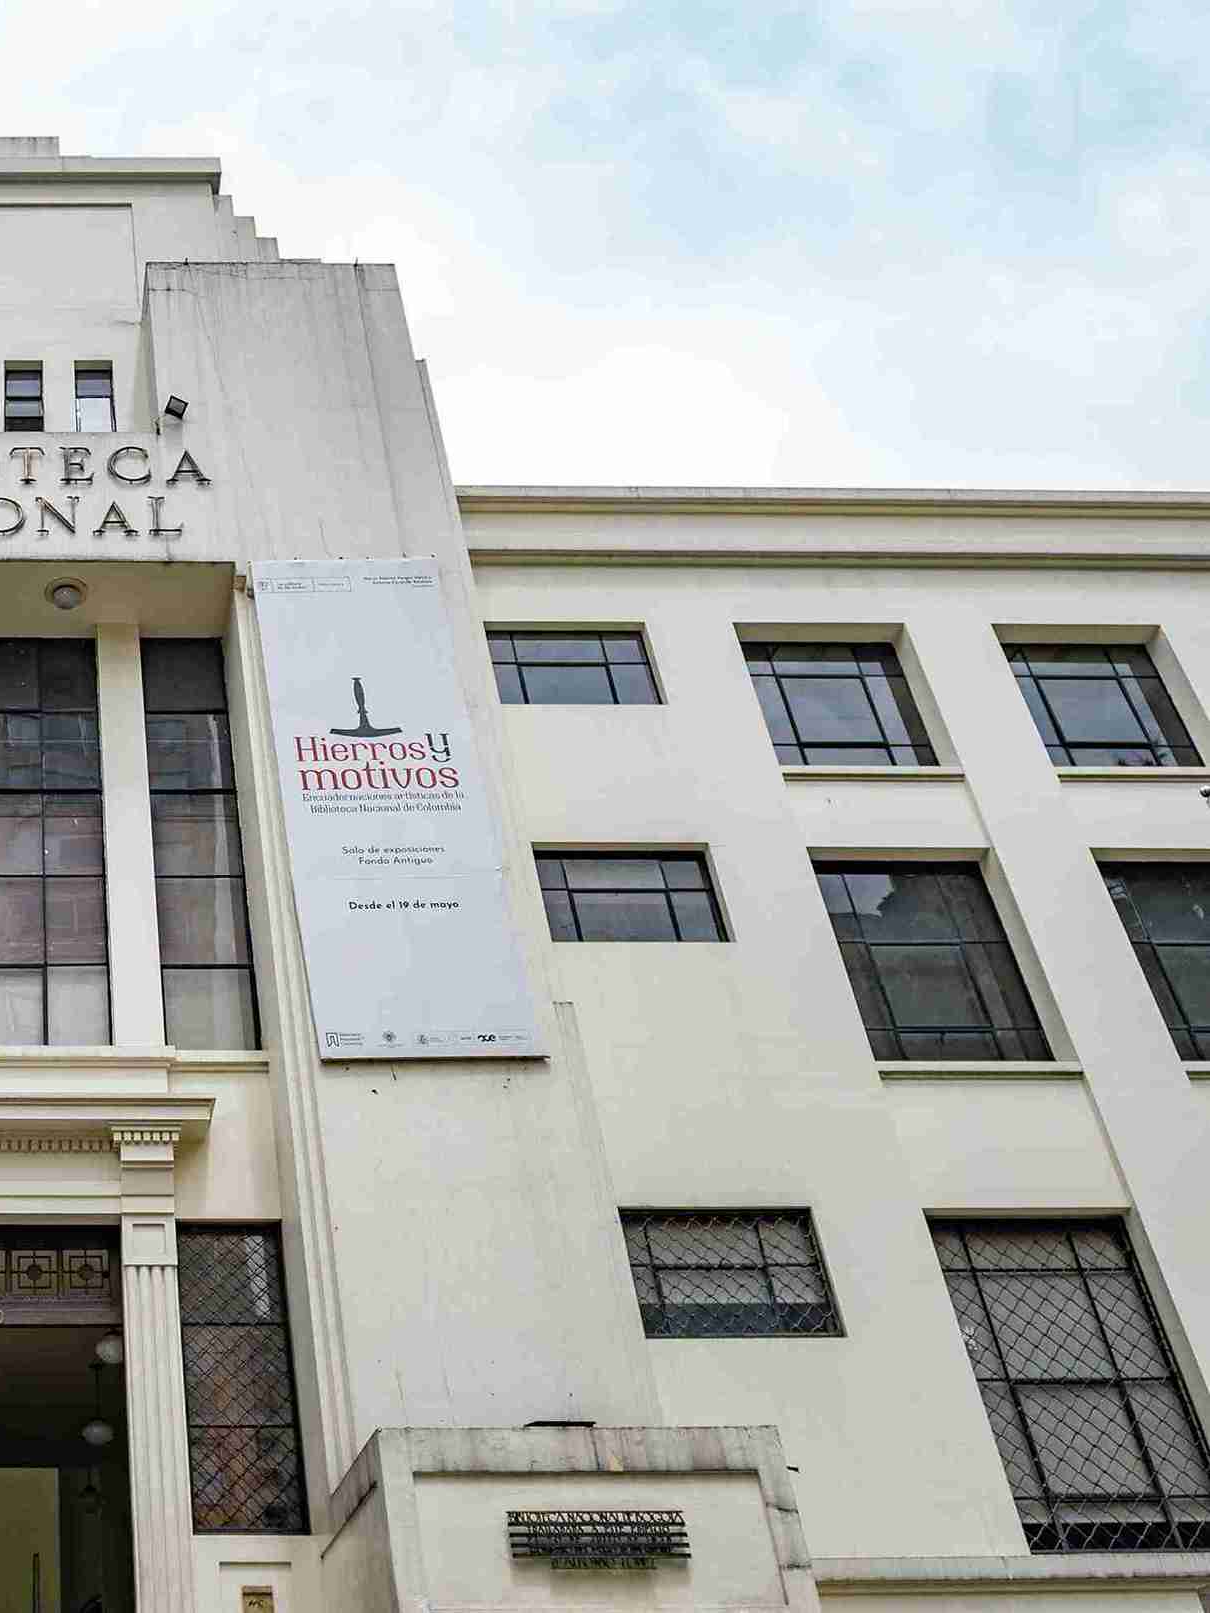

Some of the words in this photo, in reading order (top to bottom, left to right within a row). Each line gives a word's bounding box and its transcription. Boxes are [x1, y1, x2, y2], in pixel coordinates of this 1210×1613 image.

[293, 736, 427, 762] Hierros
[425, 733, 451, 763] y
[299, 761, 460, 790] motivos
[310, 803, 357, 814] Biblioteca
[360, 803, 401, 813] Nacional
[416, 802, 461, 813] Colombia
[367, 845, 380, 854] de
[383, 845, 446, 855] exposiciones
[358, 856, 390, 865] Fondo
[393, 856, 434, 866] Antiguo
[349, 900, 382, 910] Desde
[386, 900, 395, 910] el
[398, 900, 409, 909] 19
[413, 900, 426, 909] de
[430, 901, 459, 910] mayo
